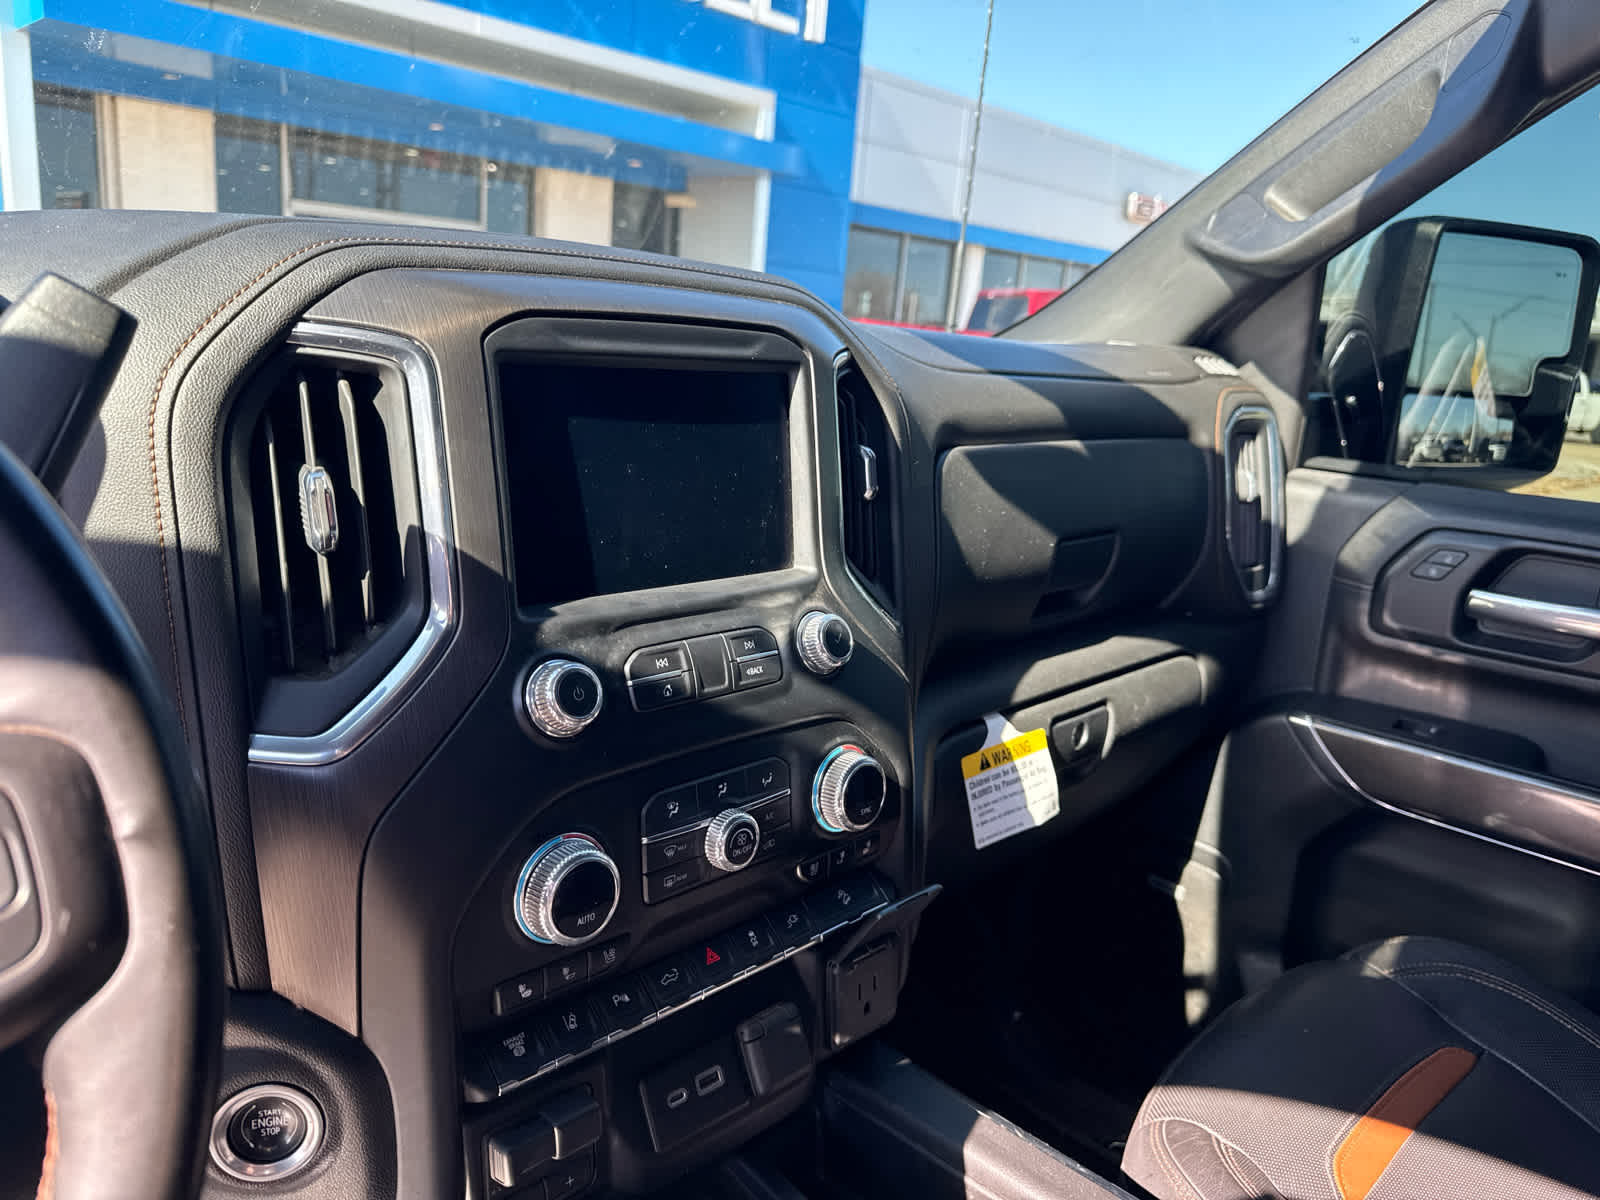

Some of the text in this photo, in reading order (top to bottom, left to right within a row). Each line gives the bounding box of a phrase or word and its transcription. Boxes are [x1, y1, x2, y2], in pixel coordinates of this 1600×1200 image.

[577, 912, 596, 927] AUTO
[258, 1108, 282, 1118] START
[251, 1116, 289, 1131] ENGINE
[261, 1127, 281, 1138] STOP
